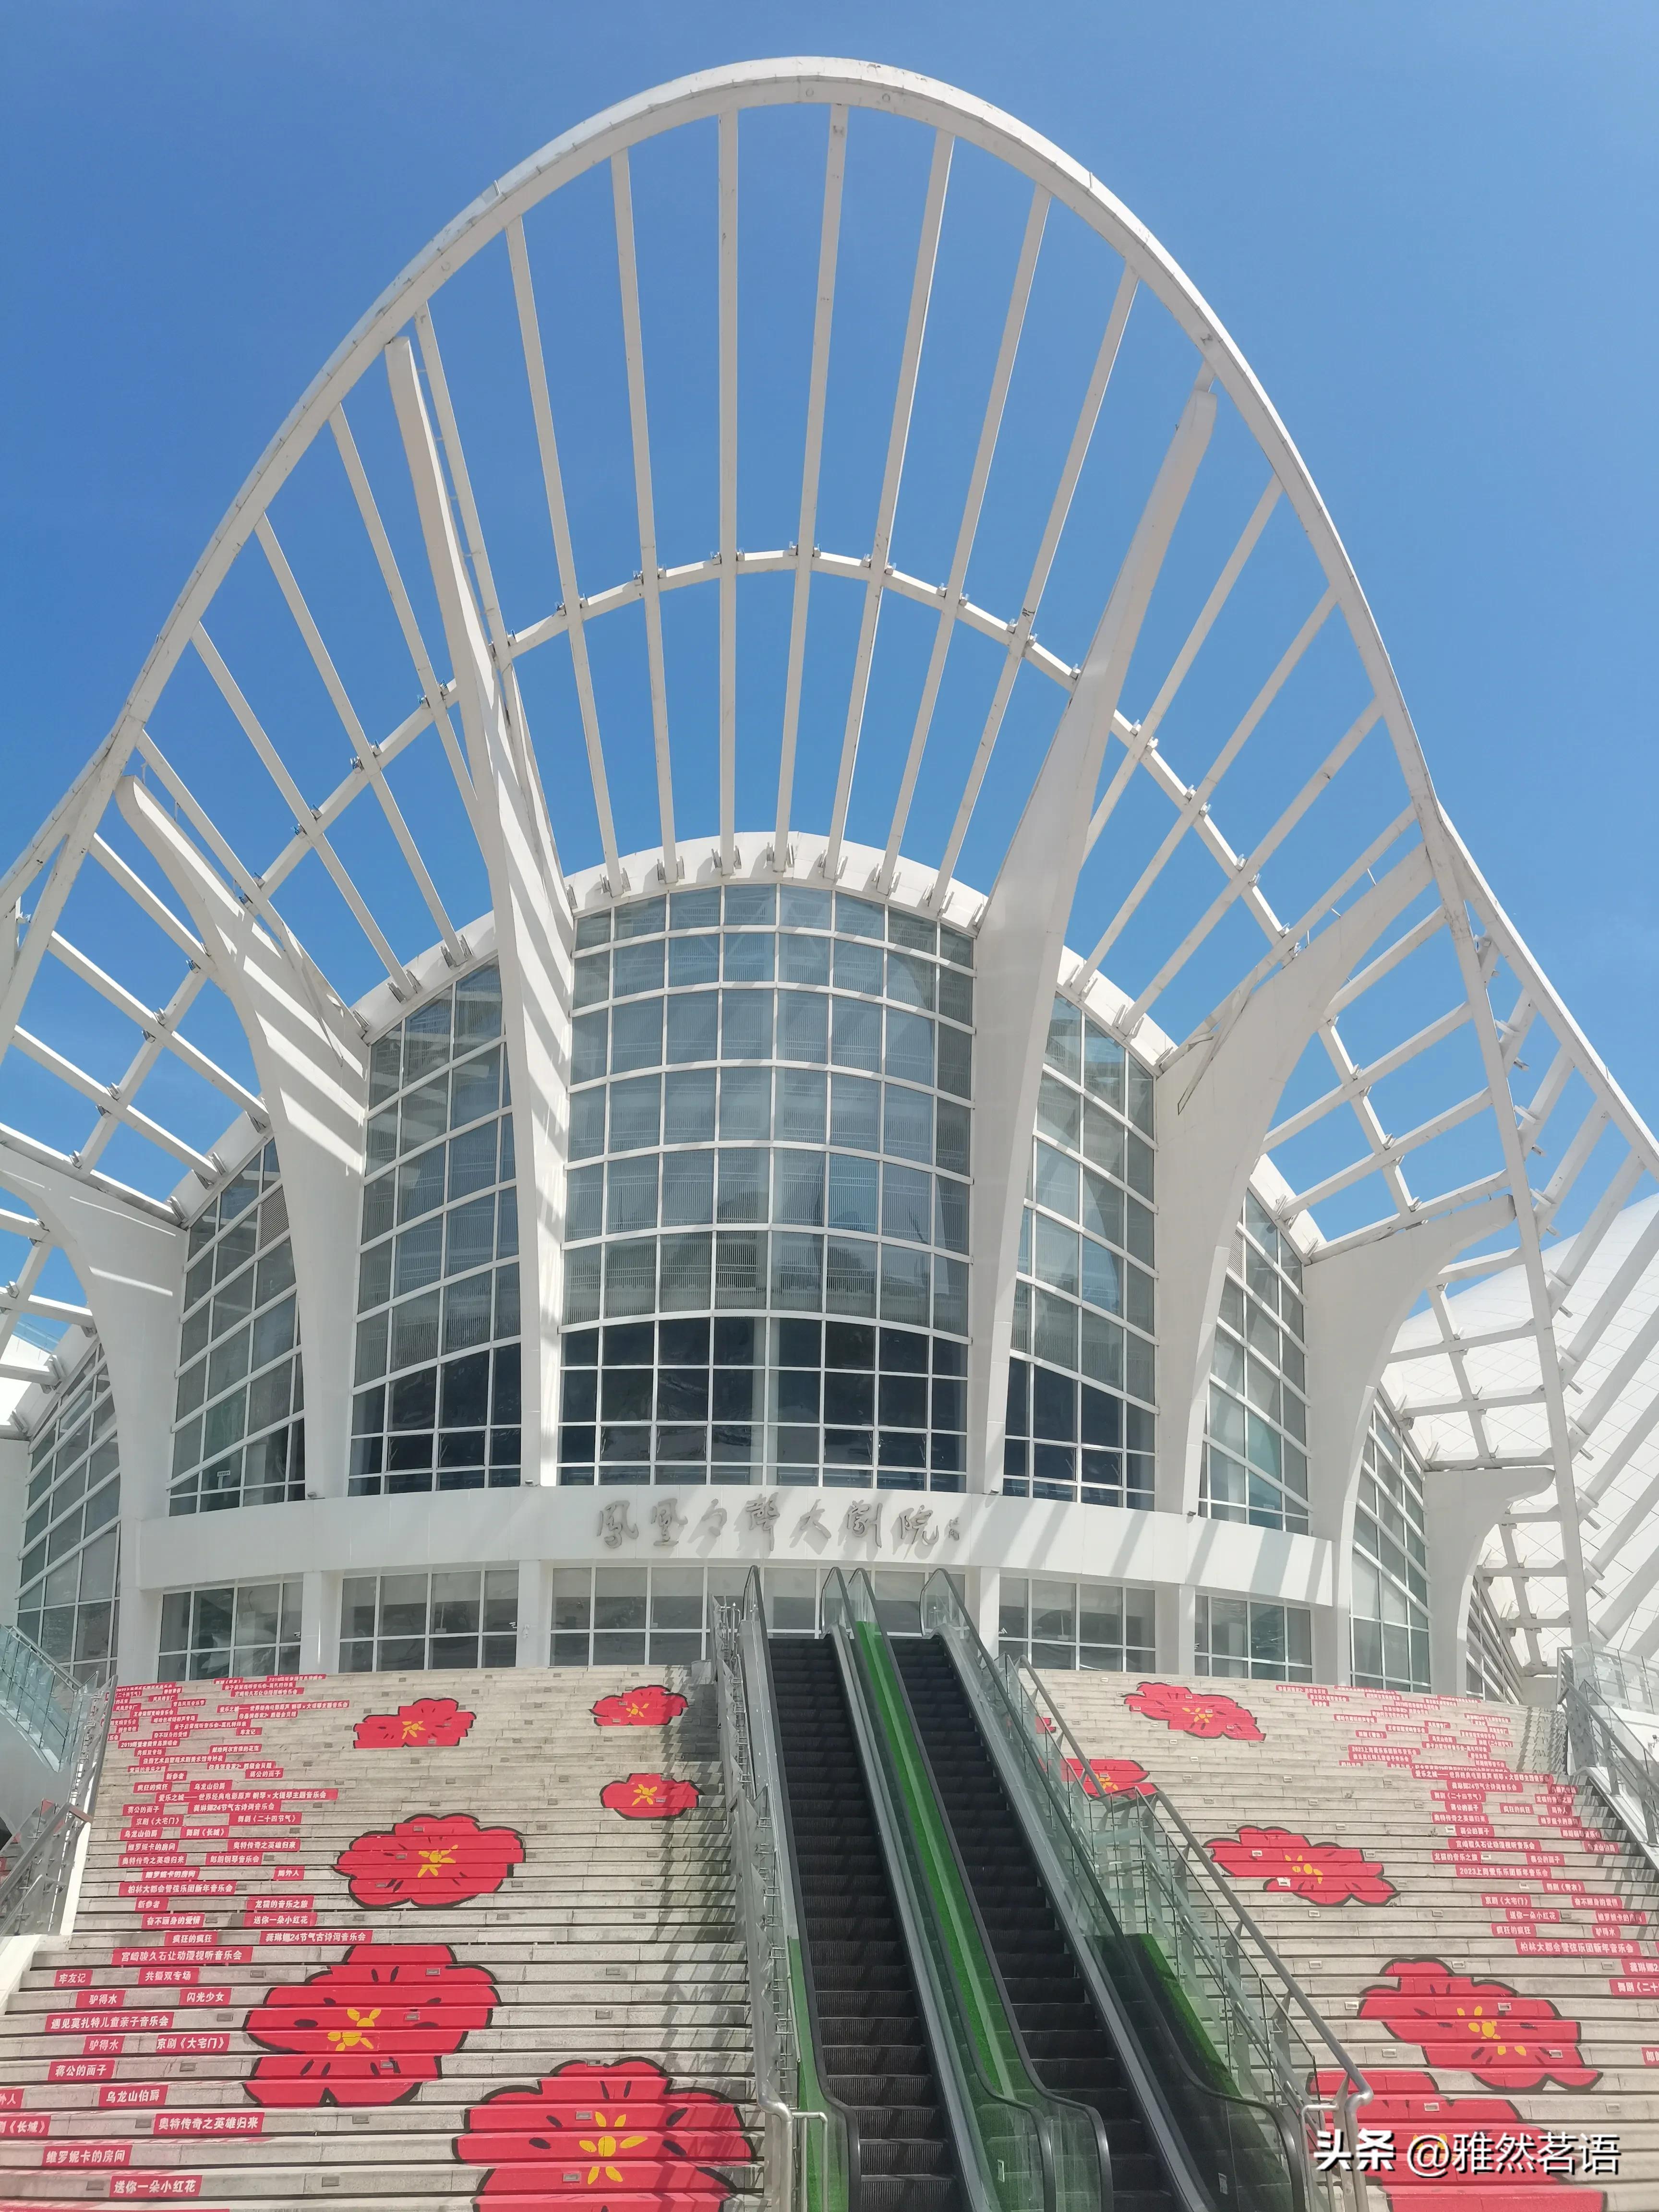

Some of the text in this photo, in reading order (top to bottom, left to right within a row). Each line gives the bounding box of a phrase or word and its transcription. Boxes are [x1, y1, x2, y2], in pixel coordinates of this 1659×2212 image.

[255, 1899, 308, 1909] 龙猫的音乐之旅
[146, 1915, 200, 1926] 奋不顾身的爱情
[253, 1914, 308, 1925] 送你一朵小红花
[172, 1934, 212, 1944] 疯狂的疯狂
[121, 1950, 242, 1962] 宫崎骏久石让动漫视听音乐会
[1629, 1962, 1659, 1973] 龚琳娜2
[1617, 1982, 1659, 1993] 舞剧《二十
[89, 1992, 117, 2005] 驴得水
[186, 1991, 225, 2003] 闪光少女
[51, 2014, 169, 2030] 遇见莫扎特儿童亲子音乐会
[89, 2038, 119, 2051] 驴得水
[157, 2037, 227, 2049] 京剧《大宅门》
[55, 2064, 107, 2078] 蒋公的面子
[106, 2089, 160, 2104] 乌龙山伯爵
[158, 2116, 258, 2129] 奥特传奇之英雄归来
[46, 2149, 125, 2164] 维罗妮卡的房间
[113, 2179, 196, 2194] 送你一朵小红花
